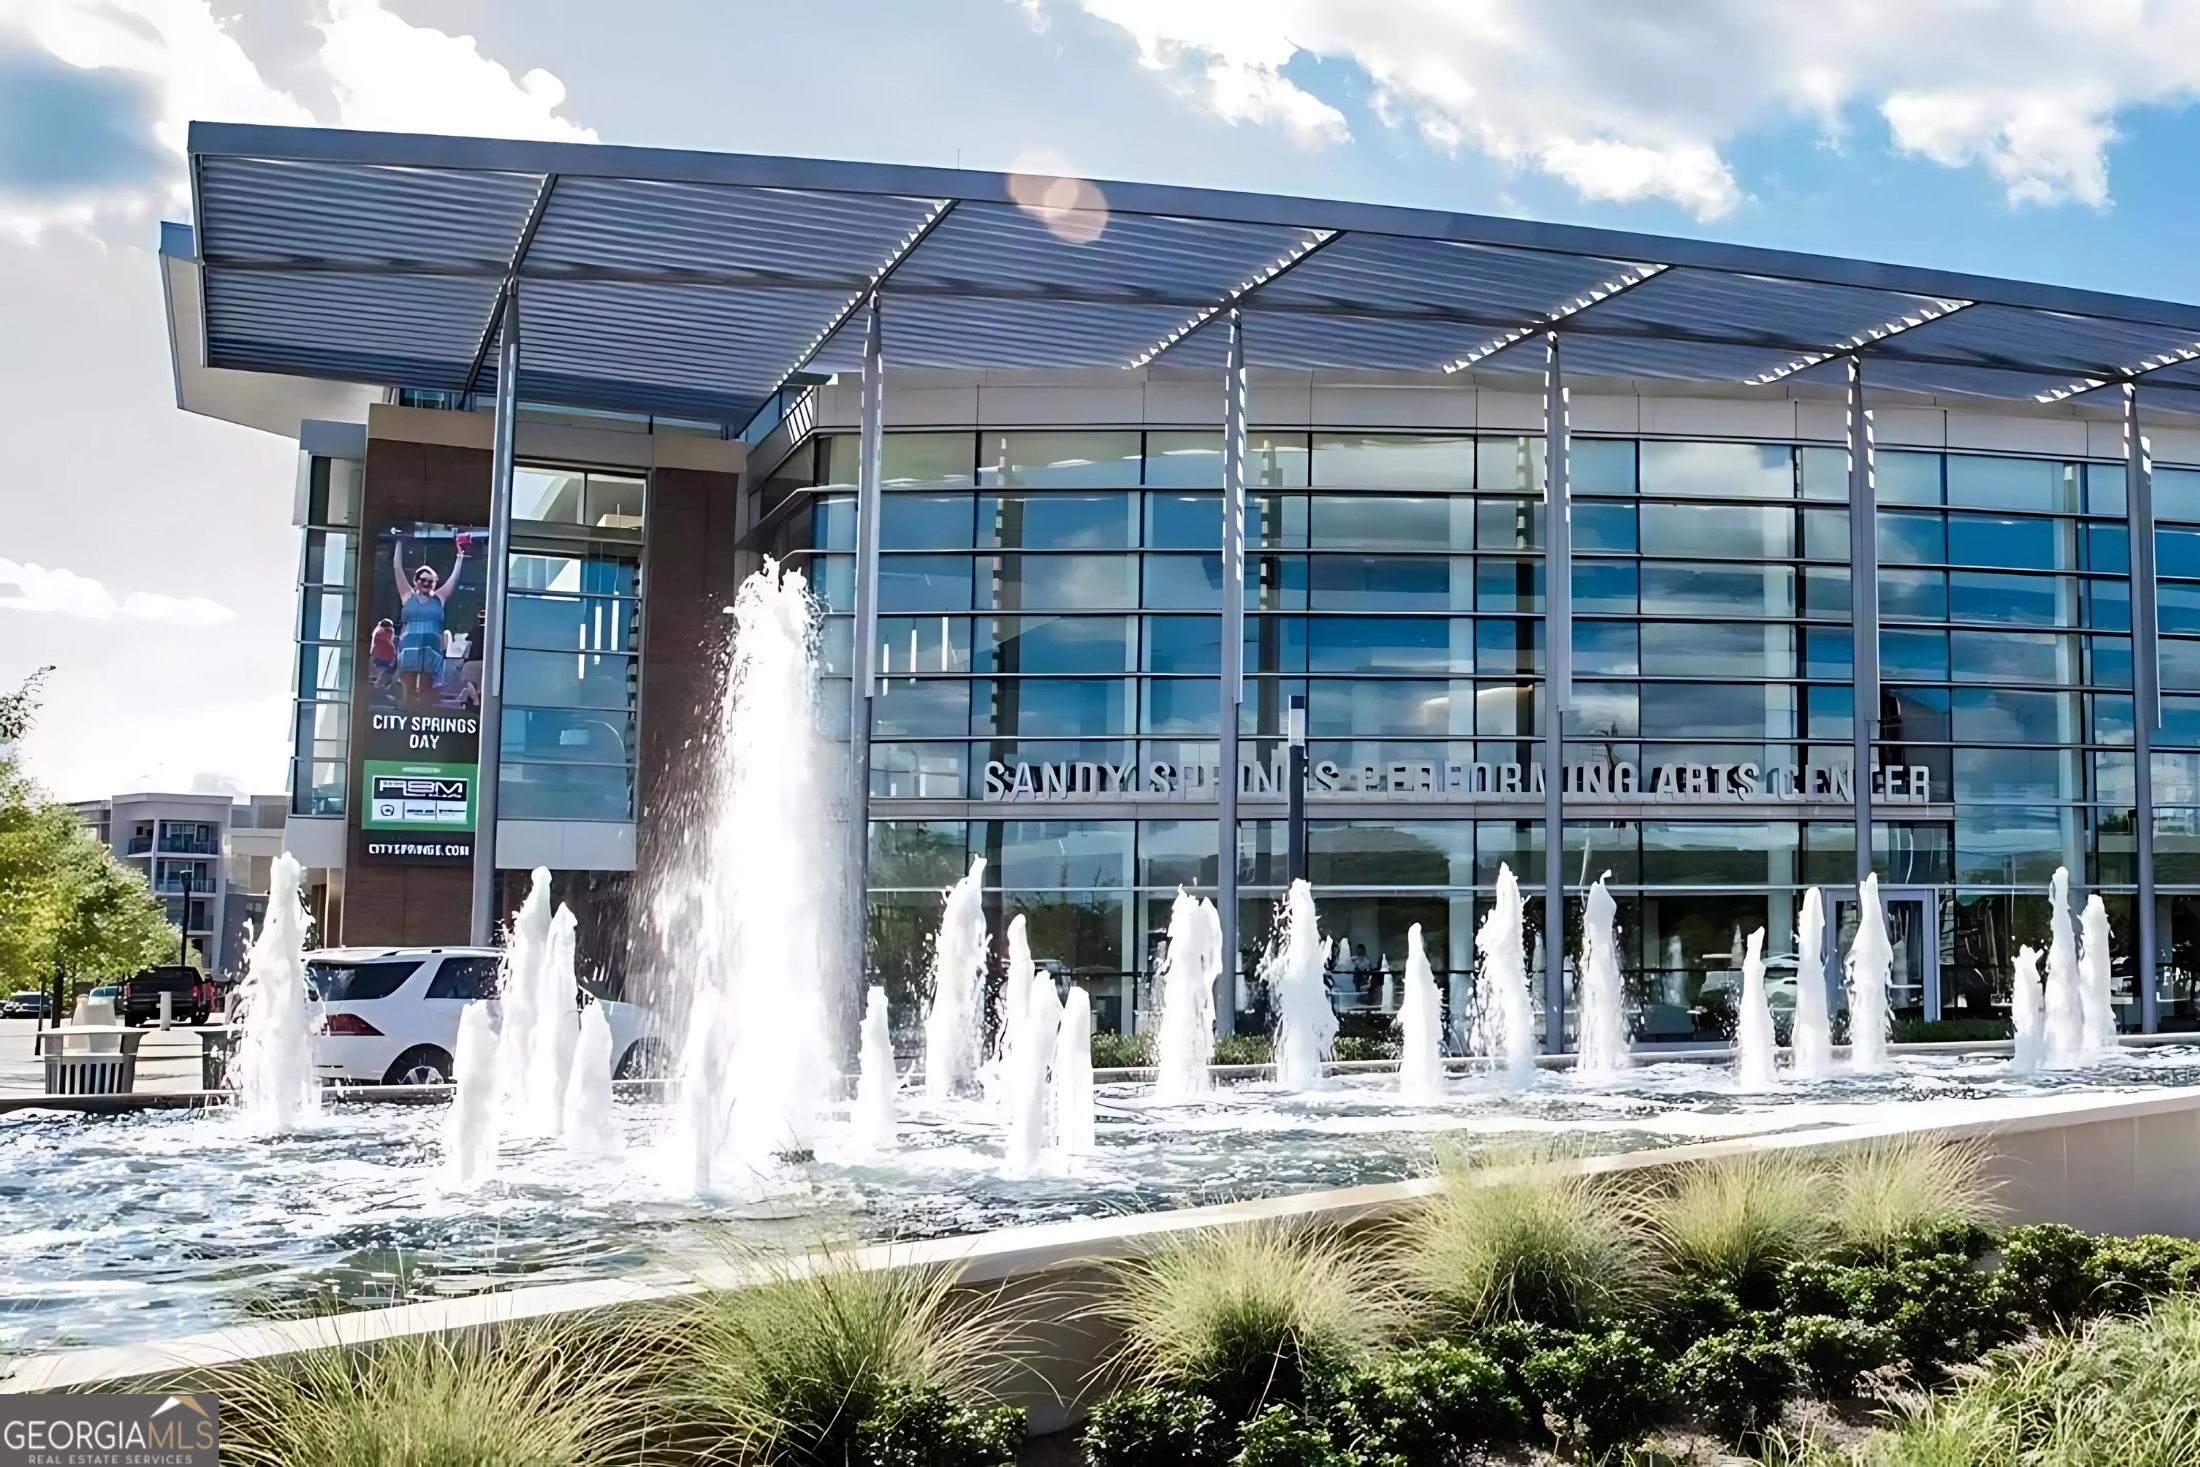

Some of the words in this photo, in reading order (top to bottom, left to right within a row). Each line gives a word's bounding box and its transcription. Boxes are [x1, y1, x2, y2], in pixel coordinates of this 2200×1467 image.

[373, 715, 407, 730] CITY
[411, 717, 477, 733] SPRINGS
[409, 734, 440, 749] DAY
[984, 761, 1135, 801] SANDY
[1656, 763, 1761, 802] ARTS
[1778, 764, 1931, 802] CENER
